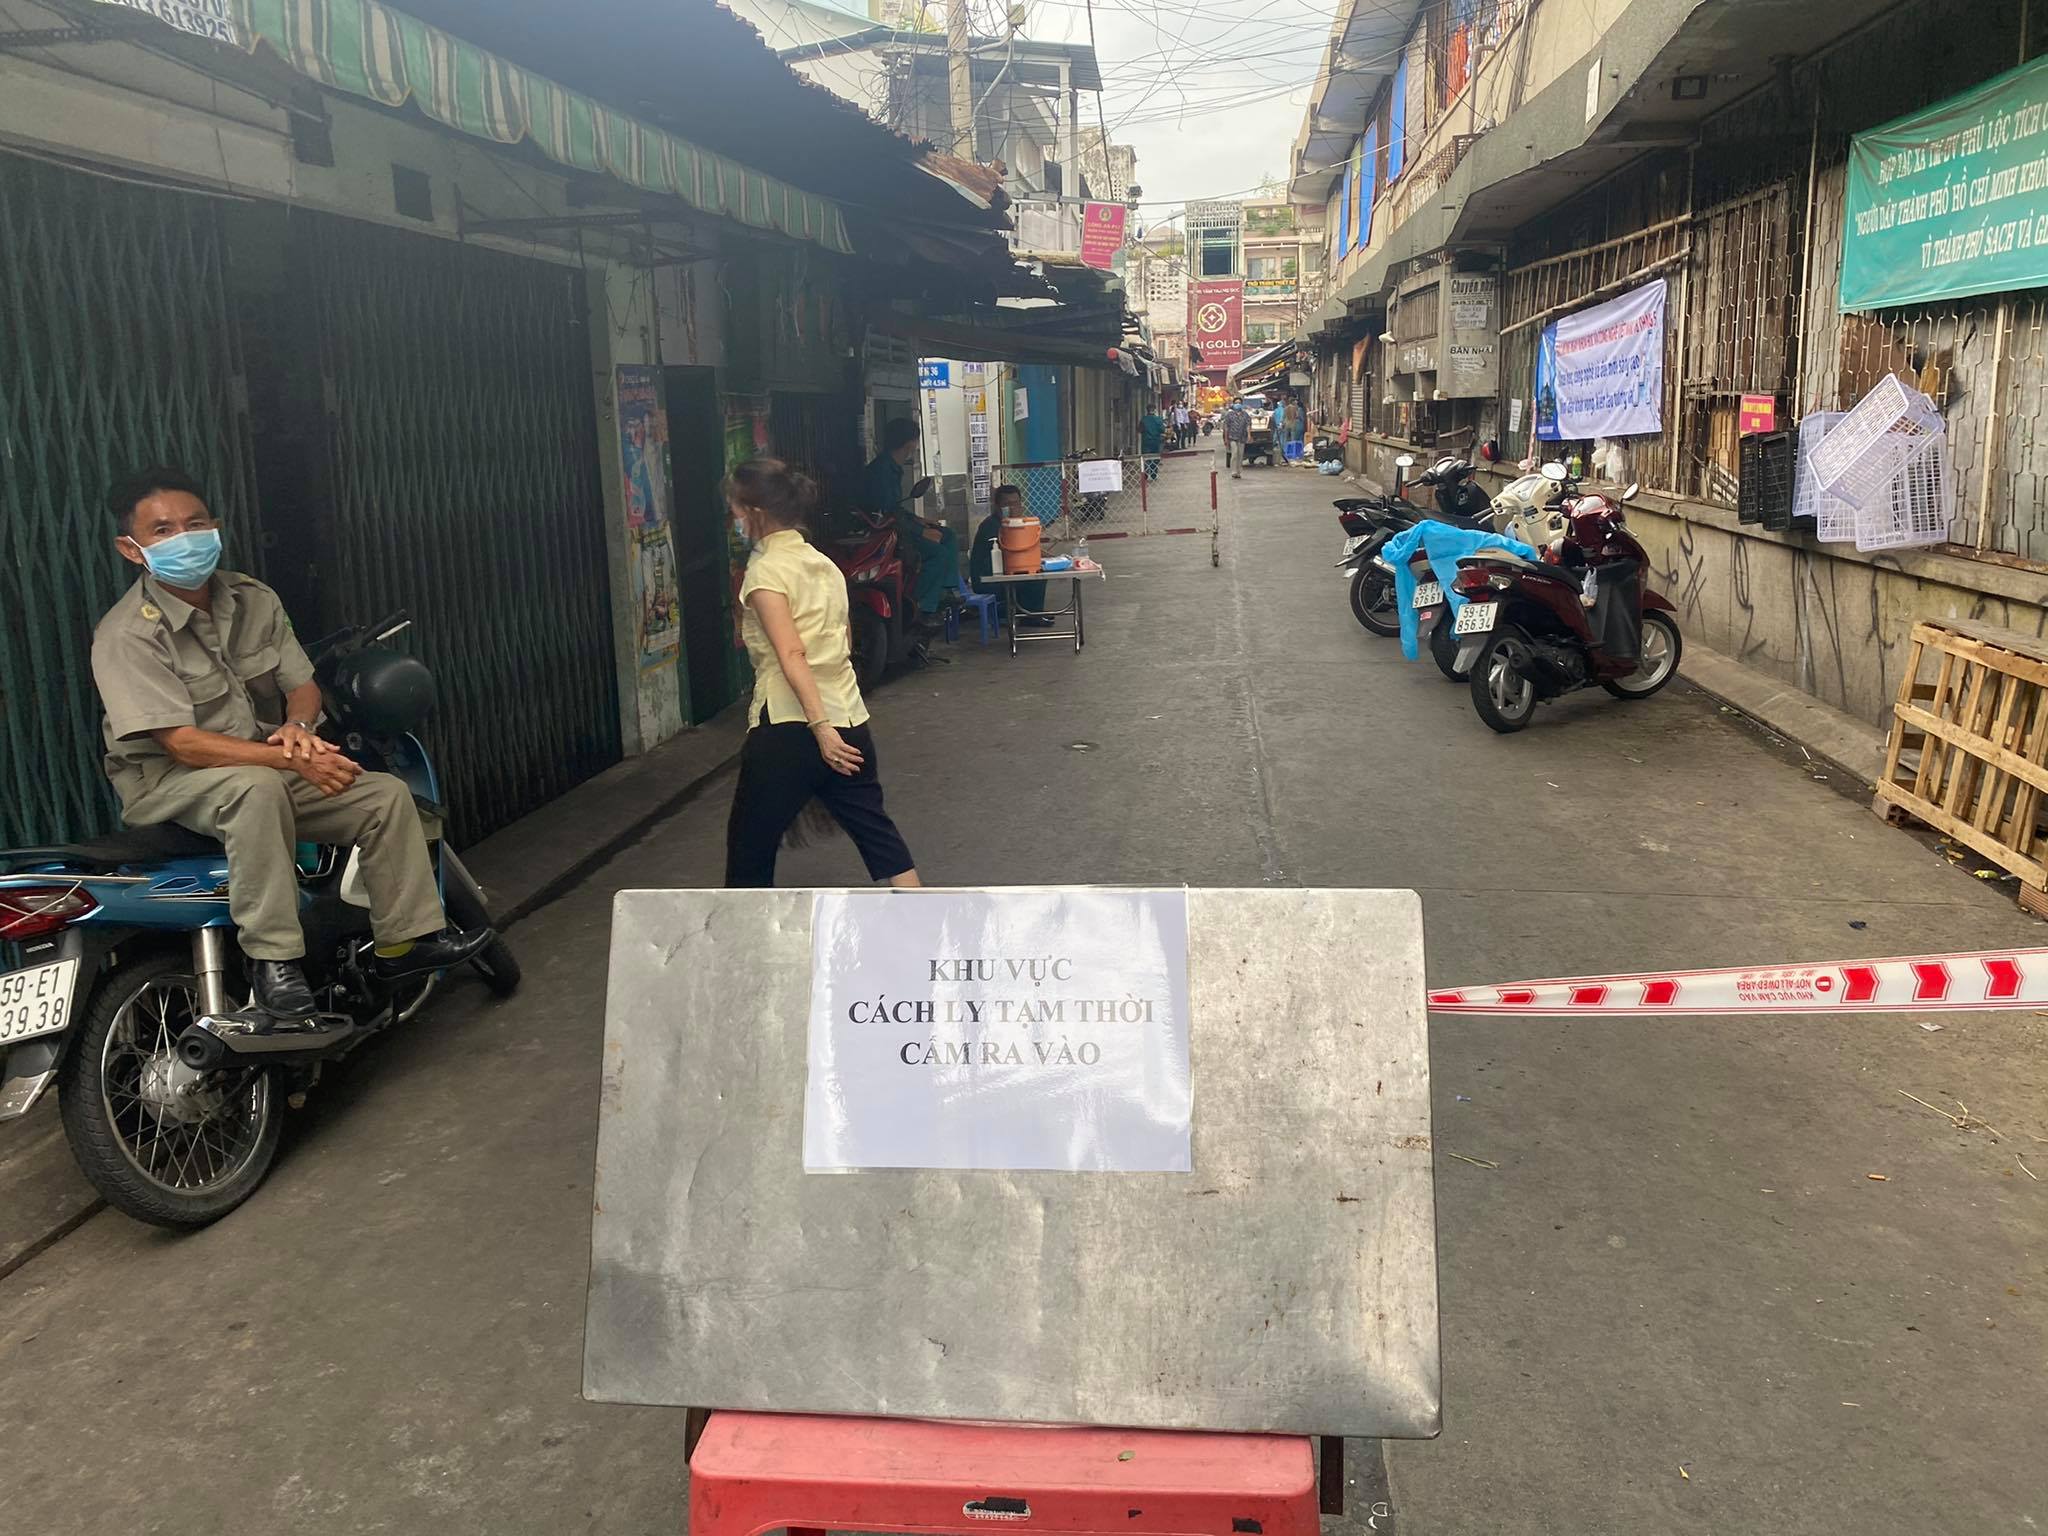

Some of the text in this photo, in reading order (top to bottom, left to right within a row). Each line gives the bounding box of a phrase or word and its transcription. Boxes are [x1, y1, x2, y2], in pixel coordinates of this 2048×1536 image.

[1961, 115, 1985, 157] PHÚ
[1987, 109, 2011, 154] LỘC
[2013, 100, 2043, 141] TÍCH
[1897, 189, 1928, 226] THÀNH
[1929, 172, 1952, 218] PHỐ
[1952, 166, 1967, 213] HỒ
[1970, 166, 1991, 208] CHÍ
[1988, 166, 2019, 202] MINH
[1921, 233, 1932, 270] VÌ
[1932, 229, 1965, 268] THÀNH
[1962, 214, 1989, 260] PHỐ
[1983, 221, 2017, 262] SẠCH
[1206, 340, 1240, 350] GOLD
[930, 366, 939, 376] 36
[1457, 618, 1491, 632] 856.34
[1463, 605, 1490, 619] 59-E1
[1, 966, 60, 1006] 59-E1
[928, 954, 1073, 987] KHU VỰC
[1736, 978, 1812, 991] NOT ALLOWED AREA
[848, 992, 1155, 1029] CÁCH LY TẠM THỜI
[900, 1034, 1101, 1065] CẤM RA VÀO
